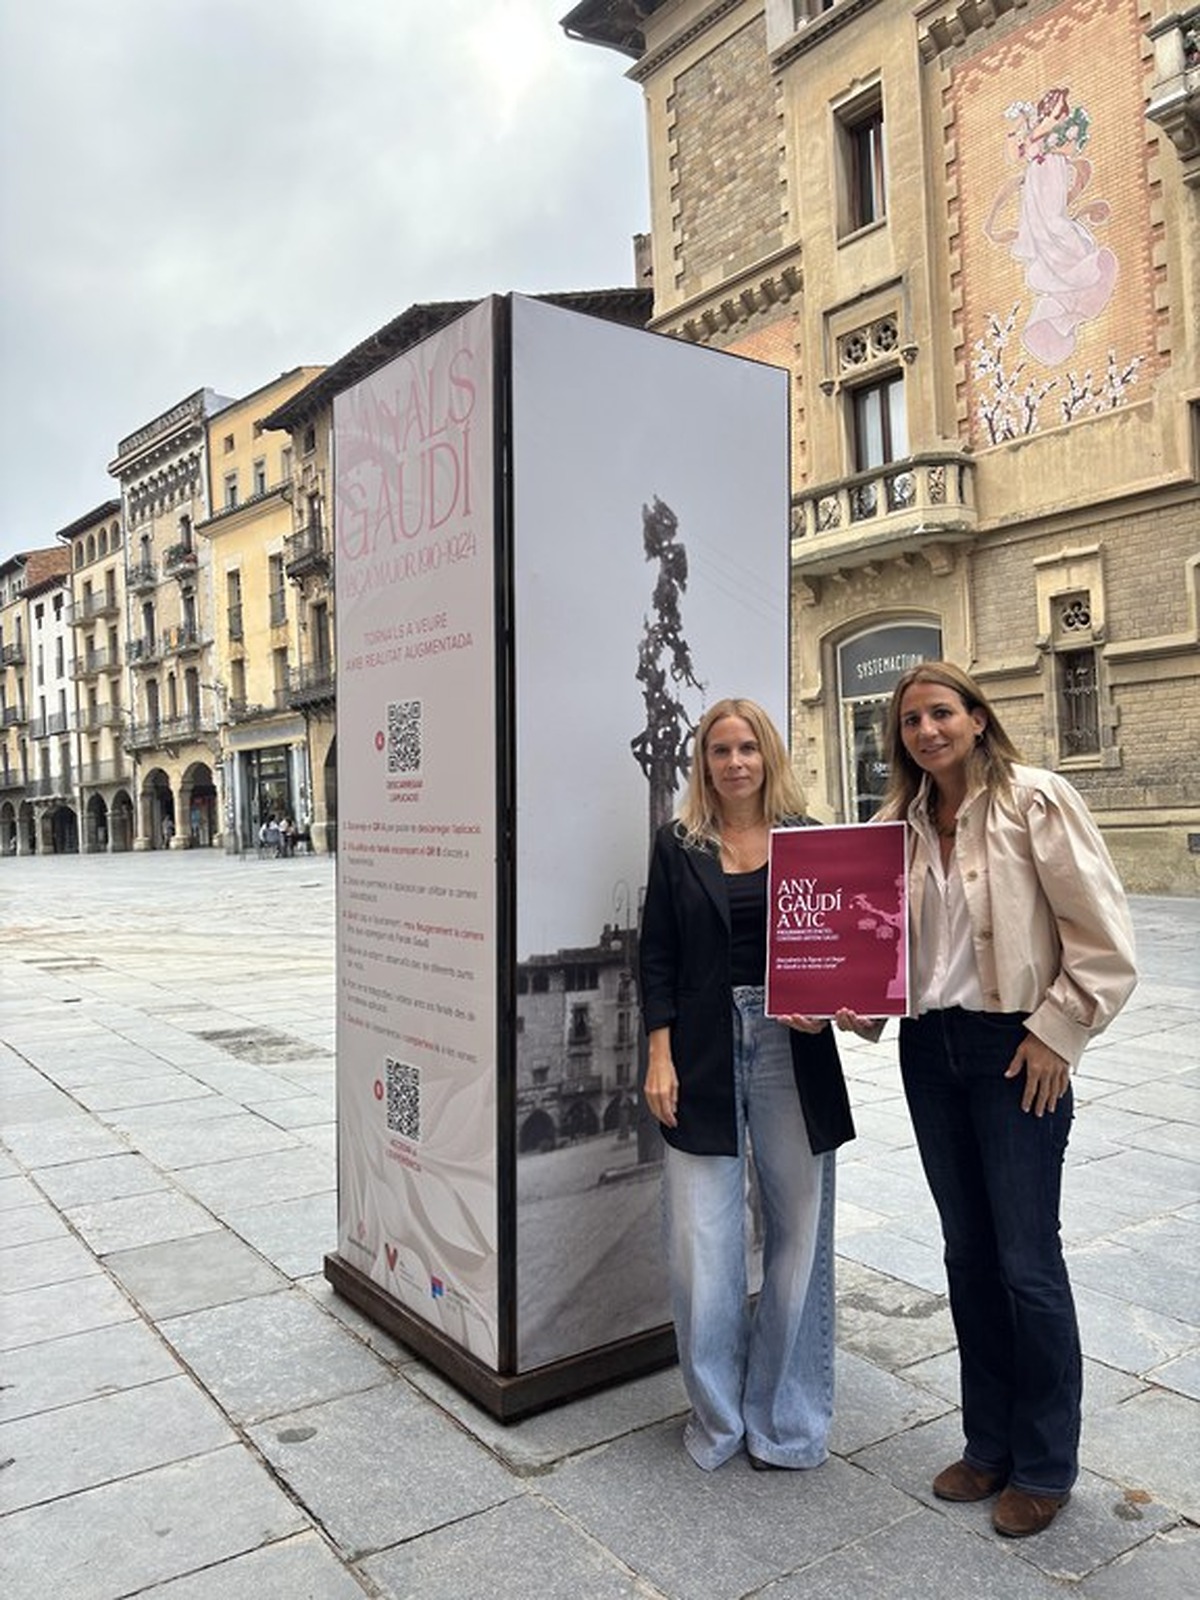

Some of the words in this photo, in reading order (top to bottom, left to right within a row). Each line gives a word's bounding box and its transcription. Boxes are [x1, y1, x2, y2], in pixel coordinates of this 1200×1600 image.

[405, 632, 473, 659] AUGMENTADA
[777, 878, 817, 895] ANY
[778, 888, 842, 913] GAUDÍ
[777, 914, 791, 928] A
[793, 911, 826, 928] VIC
